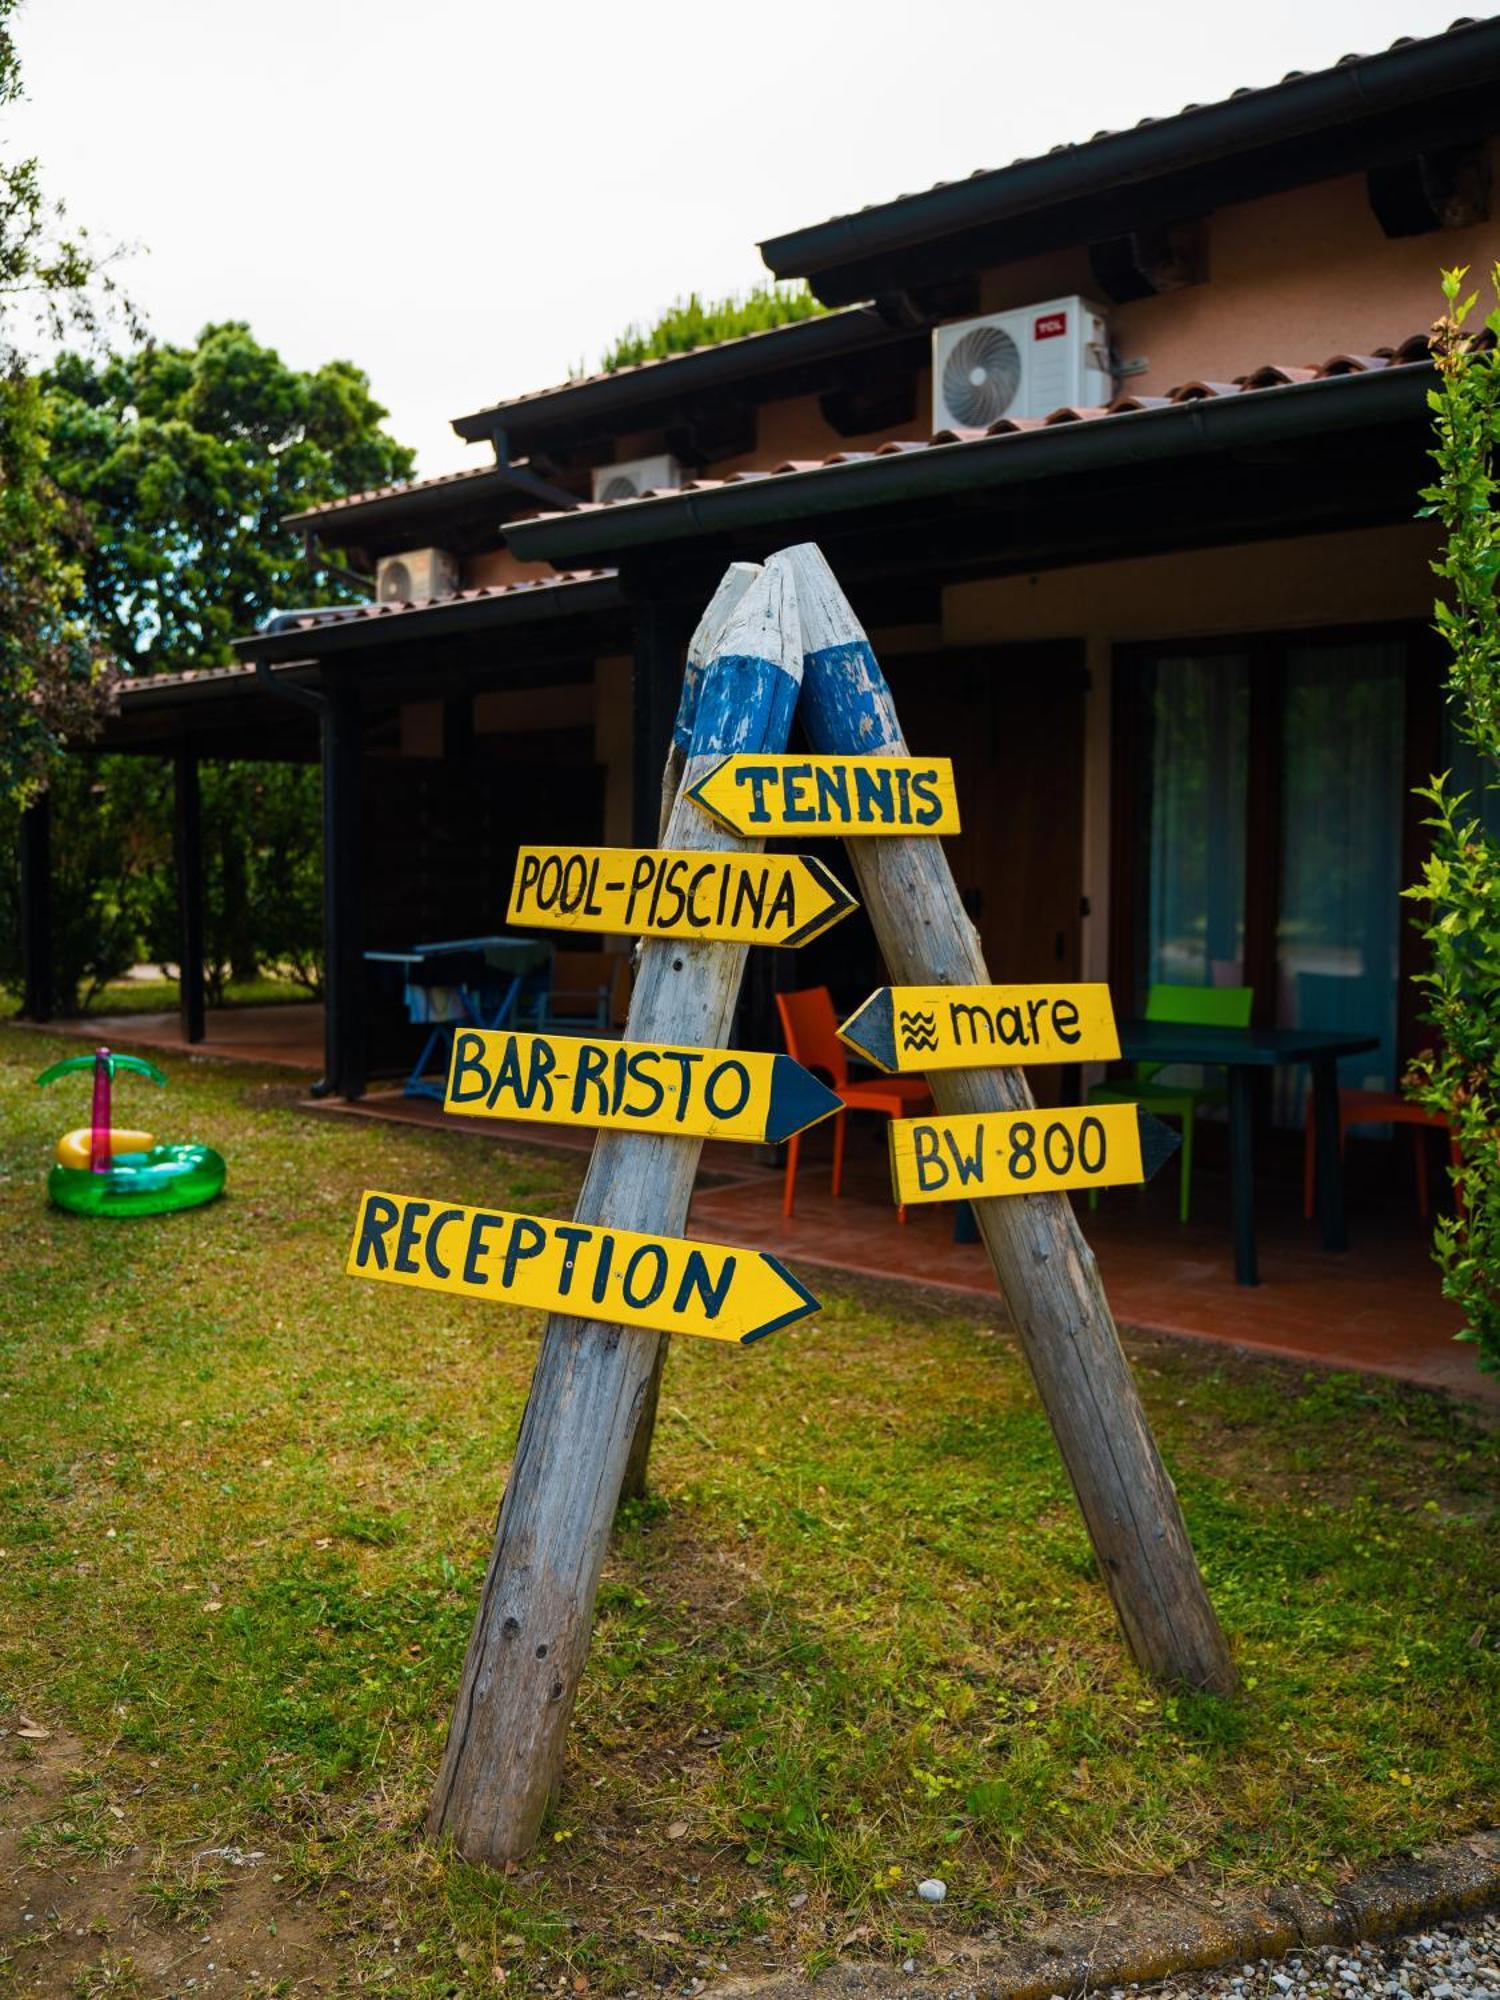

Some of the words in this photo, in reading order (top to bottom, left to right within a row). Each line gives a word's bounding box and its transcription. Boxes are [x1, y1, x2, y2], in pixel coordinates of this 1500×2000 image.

[1038, 320, 1063, 333] TCL
[735, 764, 943, 826] TENNIS
[515, 854, 796, 929] POOL-PISCINA
[950, 999, 1082, 1046] mare
[451, 1032, 751, 1123] BAR-RISTO
[913, 1123, 984, 1192] BW
[1008, 1116, 1106, 1180] 800
[356, 1196, 737, 1320] RECEPTION
